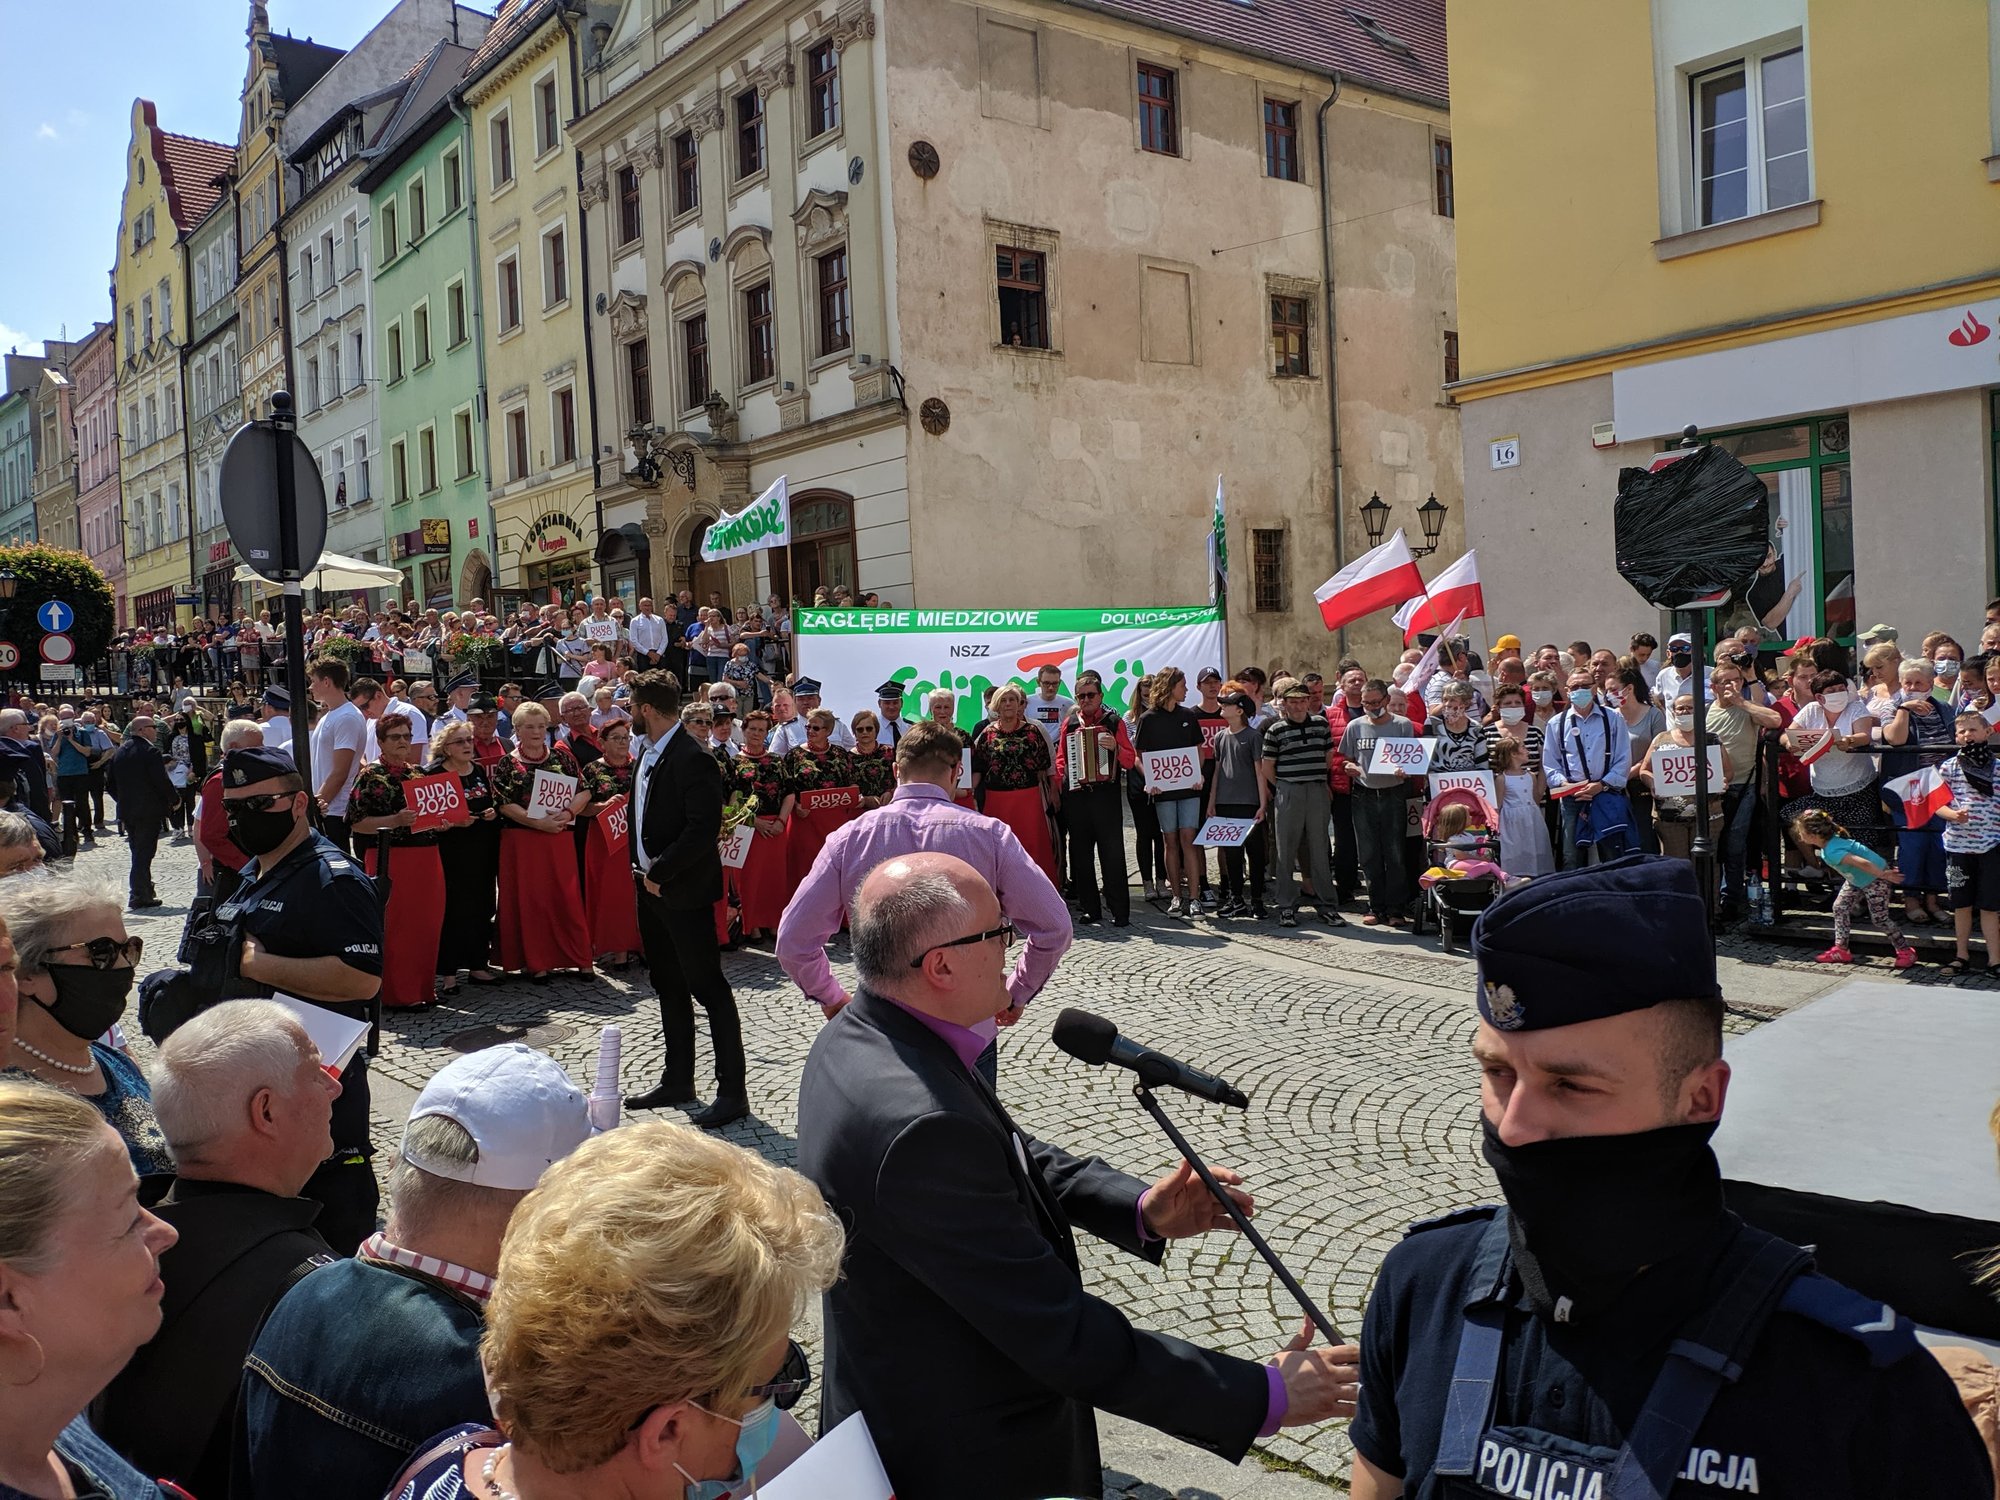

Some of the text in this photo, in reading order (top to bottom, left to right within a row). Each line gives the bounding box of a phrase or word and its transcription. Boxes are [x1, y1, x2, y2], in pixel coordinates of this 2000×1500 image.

[1495, 446, 1515, 462] 16
[800, 611, 1039, 632] ZAGŁĘBIE MIEDZIOWE
[590, 624, 611, 634] DUDA
[592, 629, 613, 638] 2020
[950, 645, 990, 658] NSZZ
[1357, 739, 1375, 751] SELE
[1383, 743, 1424, 755] DUDA
[1151, 754, 1192, 770] DUDA
[1380, 753, 1423, 765] 2020
[1153, 765, 1194, 781] 2020
[540, 778, 573, 798] DUDA
[1439, 777, 1486, 790] DUDA
[414, 780, 457, 802] DUDA
[416, 793, 460, 816] 2020
[810, 792, 852, 804] DUDA
[810, 799, 852, 809] 2020
[611, 820, 628, 840] 20
[1208, 824, 1246, 834] 2020
[1205, 832, 1242, 842] DUDA
[257, 899, 284, 913] POLICJA
[344, 943, 380, 955] POLICJA
[1475, 1440, 1605, 1500] POLICJA
